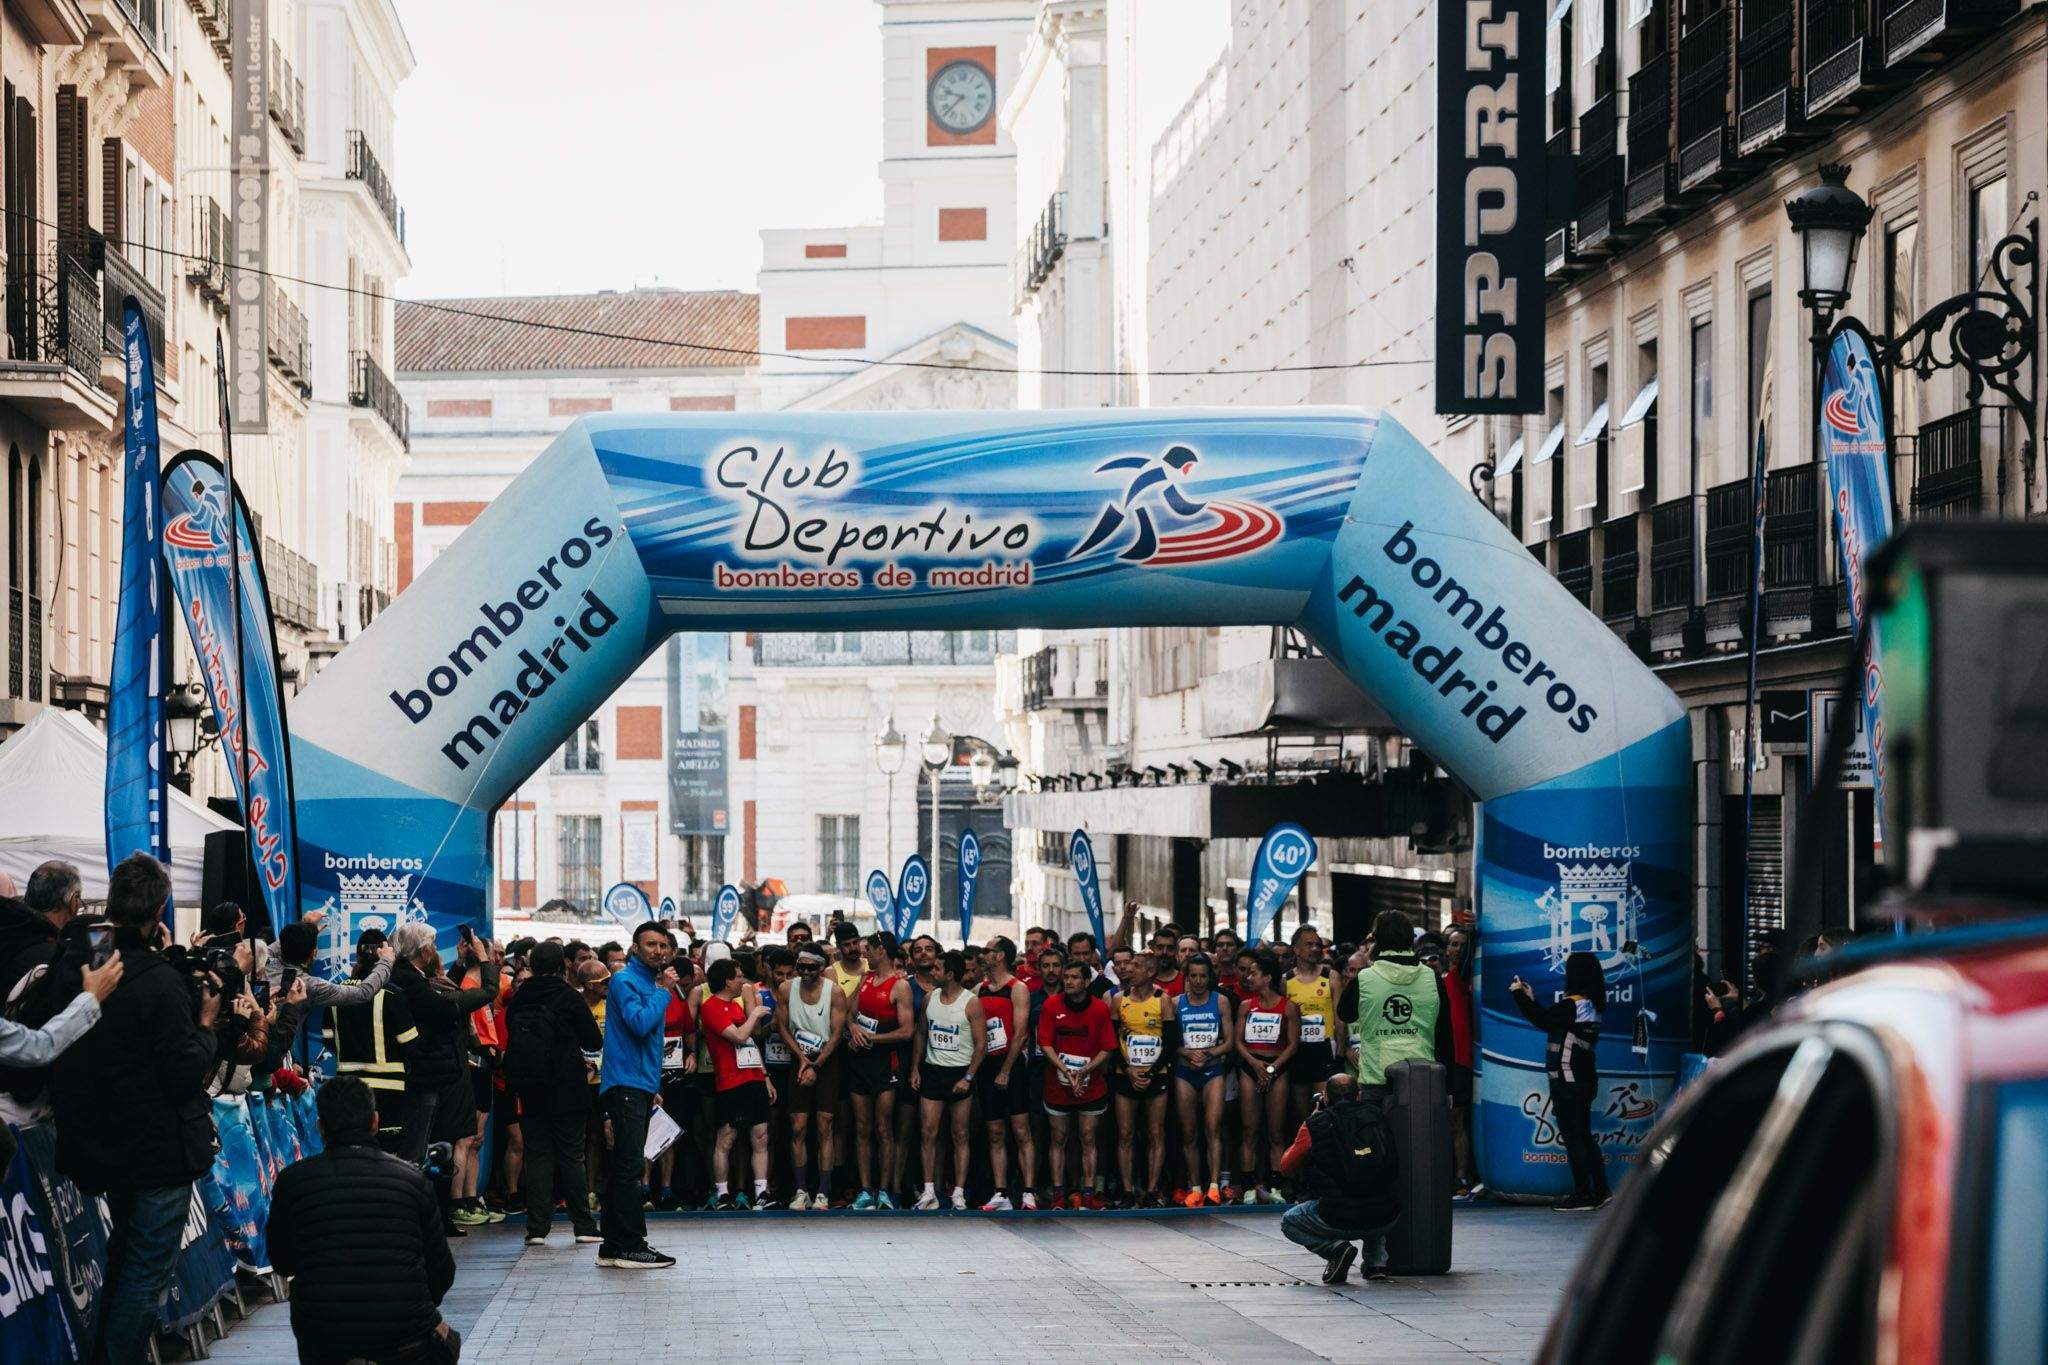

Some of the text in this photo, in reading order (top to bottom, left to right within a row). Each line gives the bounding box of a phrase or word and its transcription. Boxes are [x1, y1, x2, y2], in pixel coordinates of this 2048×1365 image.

[247, 15, 261, 70] Locker
[238, 135, 261, 251] HOOPS
[1464, 0, 1519, 399] SPORT
[238, 252, 260, 302] OF
[238, 306, 260, 423] HOUSE
[716, 446, 850, 489] Club
[745, 490, 1029, 565] Deportivo
[718, 561, 1031, 589] bomberos de madrid
[389, 517, 613, 725] bomberos
[1382, 520, 1598, 734] bomberos
[440, 588, 620, 772] madrid
[1337, 574, 1527, 744] madrid
[325, 852, 422, 870] bomberos
[1272, 844, 1306, 865] 40'
[1543, 843, 1641, 859] bomberos
[1253, 875, 1280, 911] sub
[933, 1033, 953, 1043] 1661
[1133, 1047, 1155, 1057] 1195
[1190, 1034, 1213, 1043] 1599
[1252, 1025, 1274, 1034] 1347
